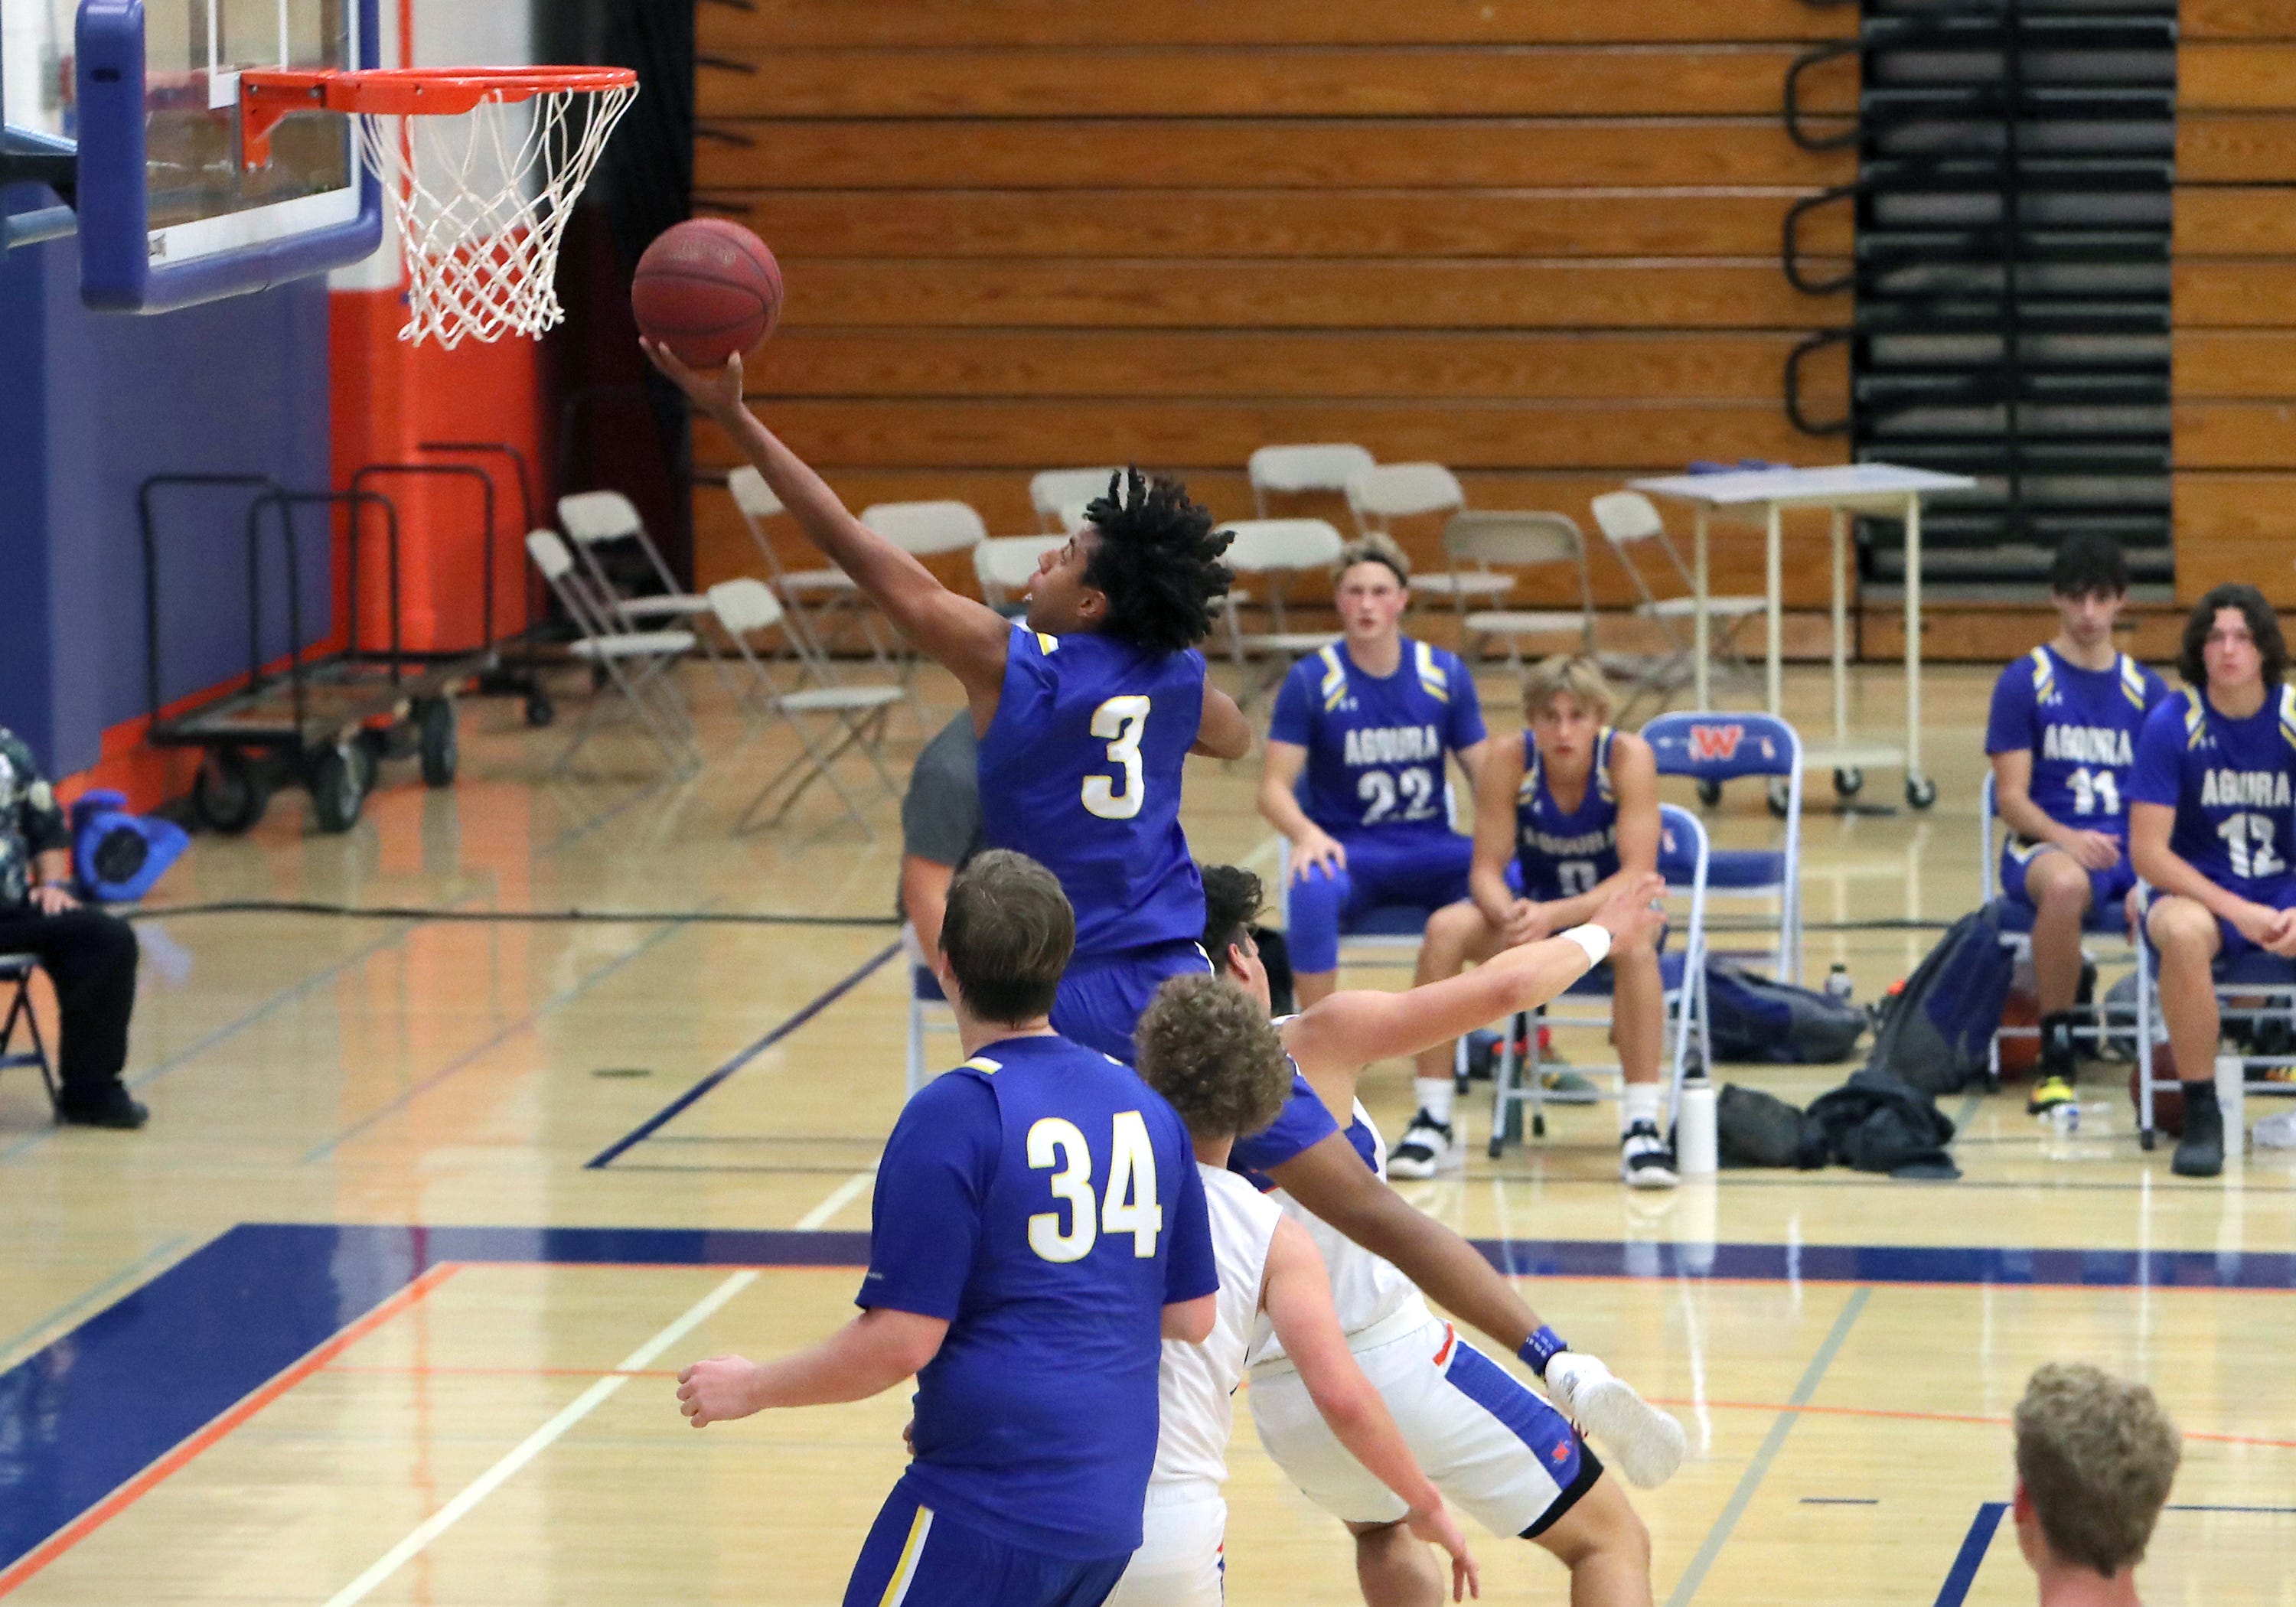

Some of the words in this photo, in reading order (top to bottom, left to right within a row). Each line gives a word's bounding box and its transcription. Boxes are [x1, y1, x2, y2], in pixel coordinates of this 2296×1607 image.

[1081, 695, 1151, 820] 3
[2201, 768, 2291, 807] AGOURA
[1357, 768, 1437, 826] 22
[2066, 768, 2119, 815] 11
[2218, 813, 2285, 878] 12
[1027, 1110, 1162, 1263] 34
